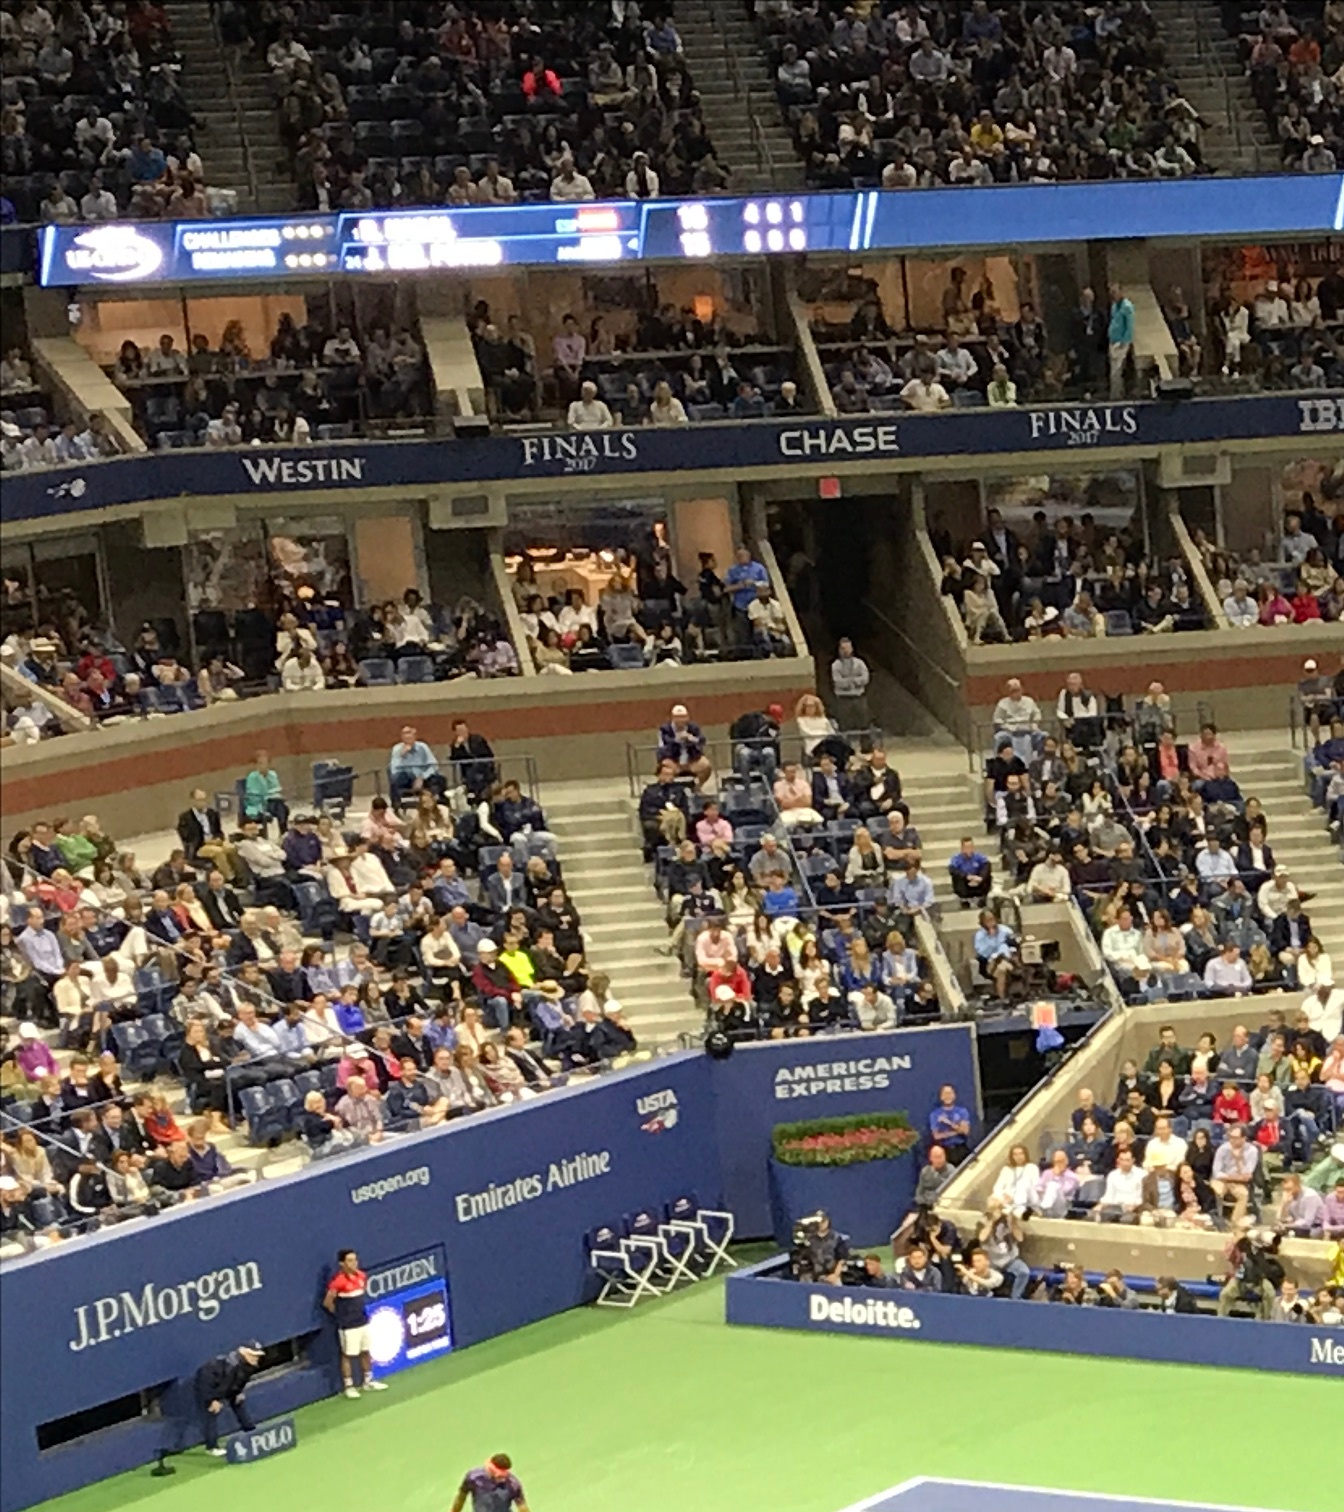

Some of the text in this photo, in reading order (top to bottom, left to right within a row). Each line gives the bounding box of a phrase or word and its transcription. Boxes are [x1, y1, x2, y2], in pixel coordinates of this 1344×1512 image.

[1029, 407, 1138, 438] FINALS
[522, 432, 638, 465] FINALS
[780, 426, 899, 456] CHASE
[242, 456, 362, 486] WESTIN
[775, 1054, 911, 1084] AMERICAN
[775, 1073, 890, 1099] EXPRESS
[636, 1089, 678, 1116] USTA
[351, 1166, 430, 1204] usopen.org
[456, 1149, 611, 1222] Emirates Airline
[366, 1255, 437, 1298] CITIZEN
[69, 1259, 262, 1352] J.P.Morgan
[250, 1426, 293, 1456] POLO
